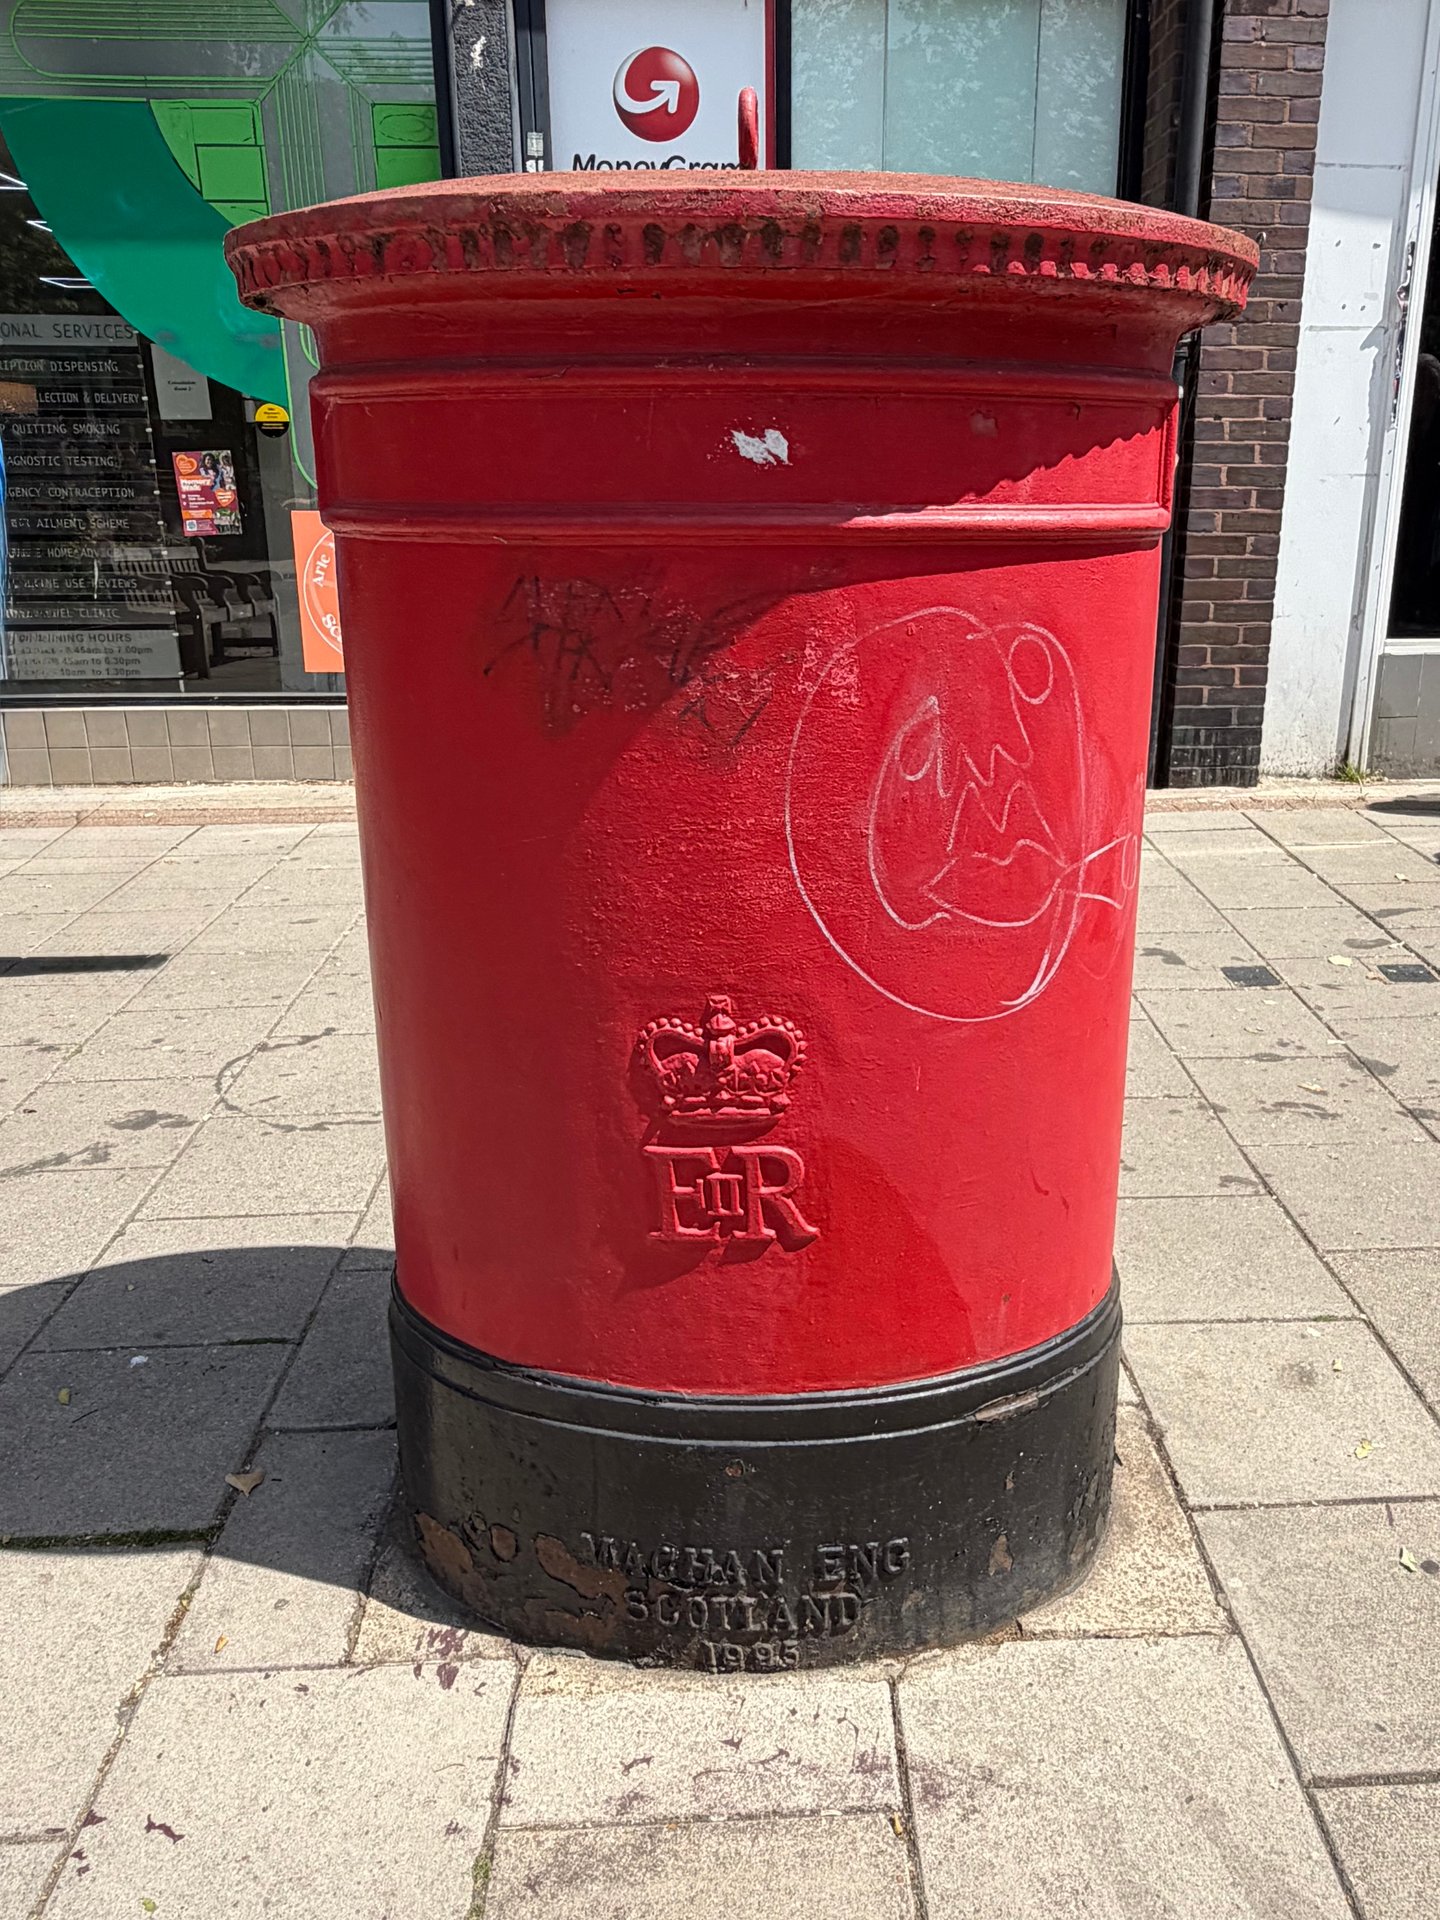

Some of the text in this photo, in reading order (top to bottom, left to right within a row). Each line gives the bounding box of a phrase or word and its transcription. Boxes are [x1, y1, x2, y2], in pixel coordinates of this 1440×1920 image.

[53, 323, 134, 339] SERVICES
[50, 360, 118, 372] DISPENSING
[83, 392, 91, 403] &
[94, 392, 139, 404] DELIVERY
[12, 423, 67, 436] QUITTING
[73, 423, 120, 435] SMOKING
[7, 456, 114, 467] AGNOSTIC TESTING
[48, 487, 135, 498] CONTRACEPTION
[90, 518, 130, 529] SCHEME
[64, 578, 86, 589] USE
[88, 633, 132, 643] HOURS
[91, 657, 101, 665] to
[91, 668, 102, 676] to
[816, 1536, 910, 1585] ENG
[623, 1589, 864, 1634] SCOTLAND
[701, 1639, 800, 1673] 1995
